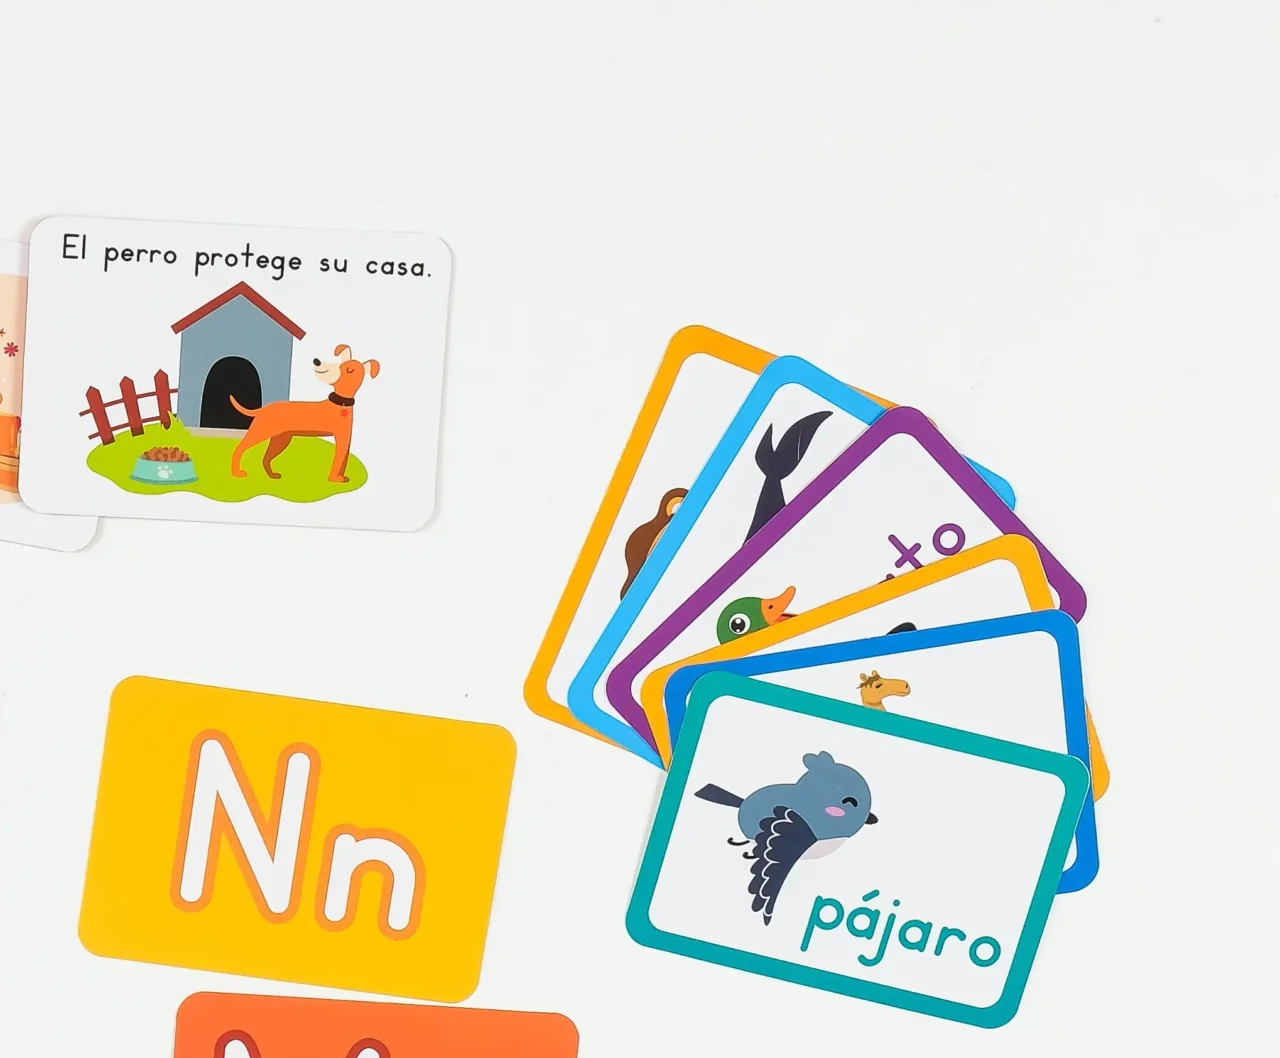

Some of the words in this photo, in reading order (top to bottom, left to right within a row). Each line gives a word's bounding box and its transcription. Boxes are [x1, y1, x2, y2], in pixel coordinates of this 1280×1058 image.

[62, 233, 87, 260] El
[103, 246, 177, 273] perro
[194, 242, 302, 281] protege
[319, 258, 348, 273] su
[365, 260, 431, 278] casa.
[180, 739, 415, 930] Nn
[800, 889, 1002, 967] pájaro
